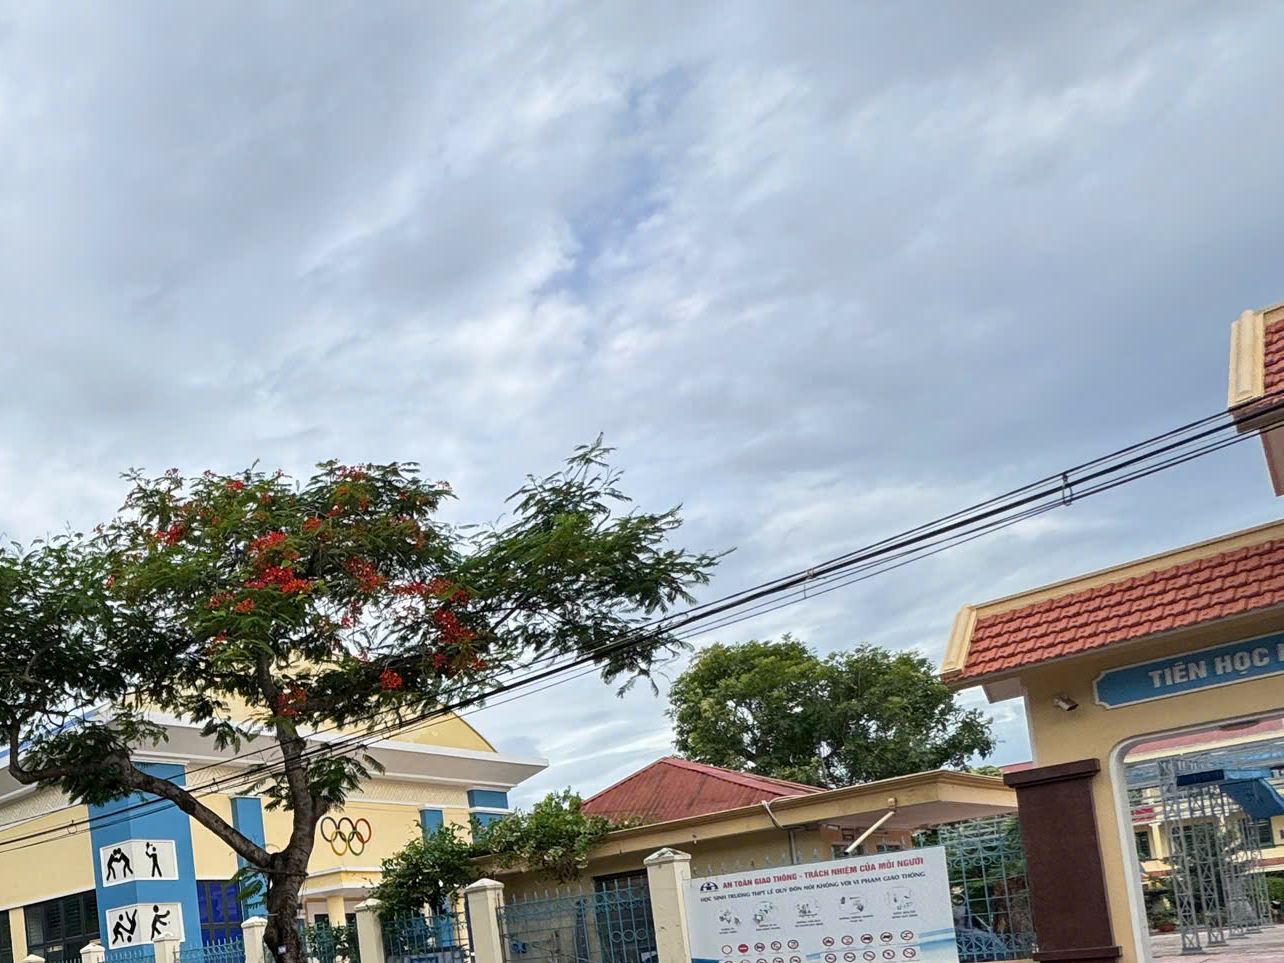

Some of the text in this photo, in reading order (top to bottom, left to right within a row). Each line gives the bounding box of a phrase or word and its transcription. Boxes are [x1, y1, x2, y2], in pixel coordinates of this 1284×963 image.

[1214, 648, 1270, 675] HỌC
[723, 881, 733, 889] AN
[754, 876, 771, 885] GIAO
